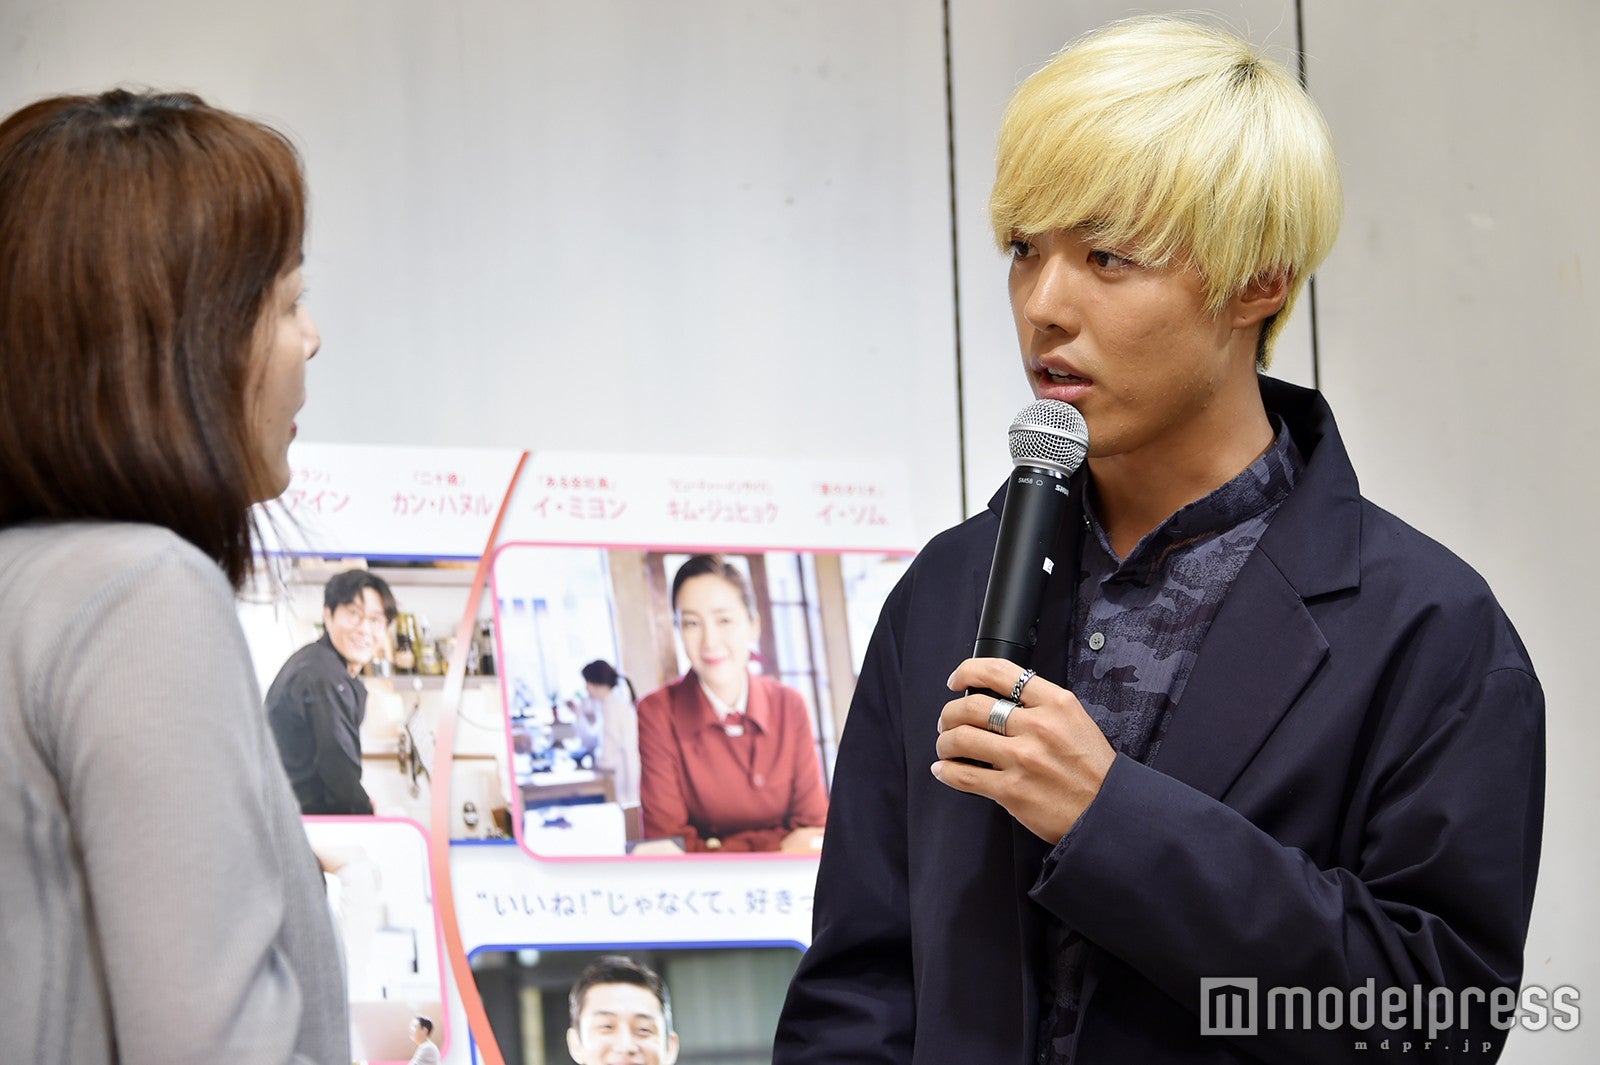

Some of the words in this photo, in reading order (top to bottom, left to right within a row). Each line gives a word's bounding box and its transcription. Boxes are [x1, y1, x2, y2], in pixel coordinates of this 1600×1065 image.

[532, 495, 629, 520] イ・ミヨン
